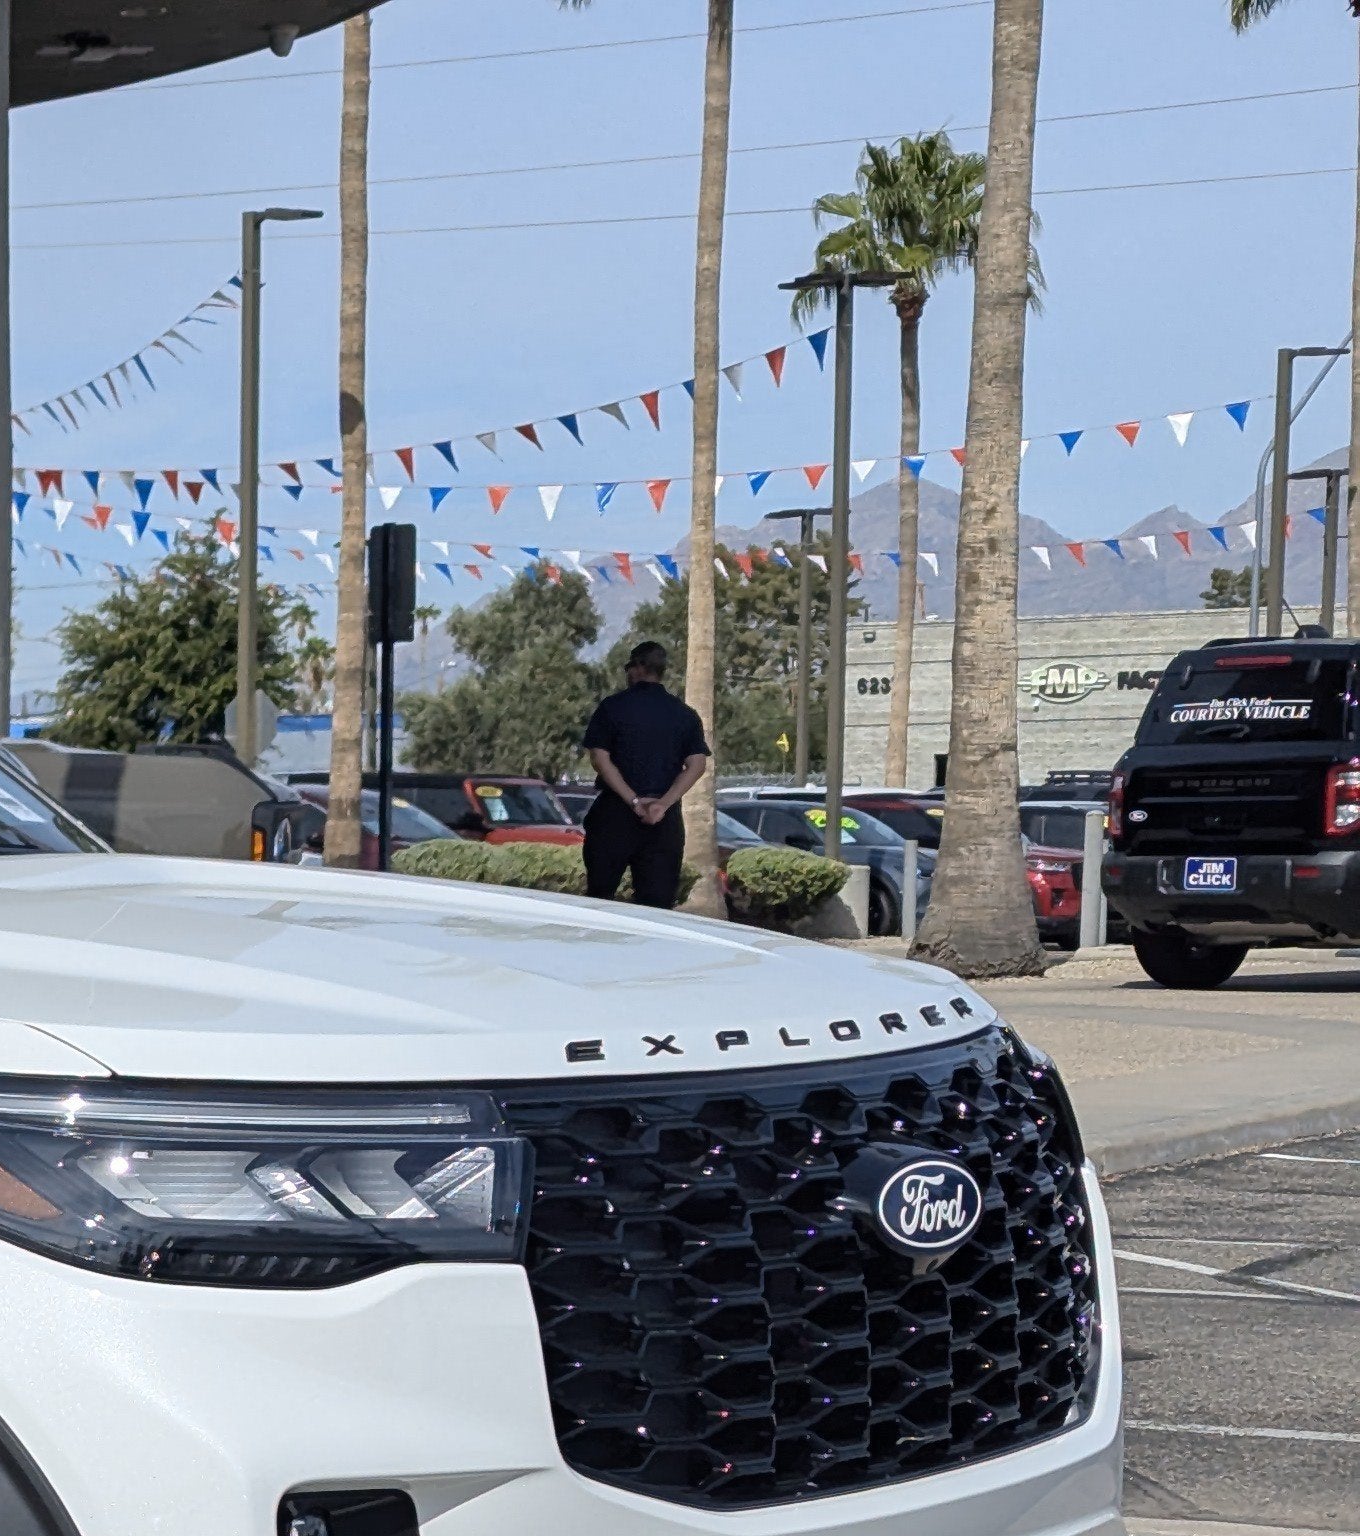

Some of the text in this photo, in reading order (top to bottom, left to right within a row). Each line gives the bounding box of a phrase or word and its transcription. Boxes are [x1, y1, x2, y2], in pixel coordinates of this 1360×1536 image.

[1030, 667, 1099, 695] FMP
[1170, 705, 1311, 723] COURTESY VEHICLE
[1189, 873, 1231, 885] CLICK
[1198, 862, 1225, 874] JIM
[564, 997, 974, 1062] EXPLORER
[899, 1173, 967, 1237] Ford
